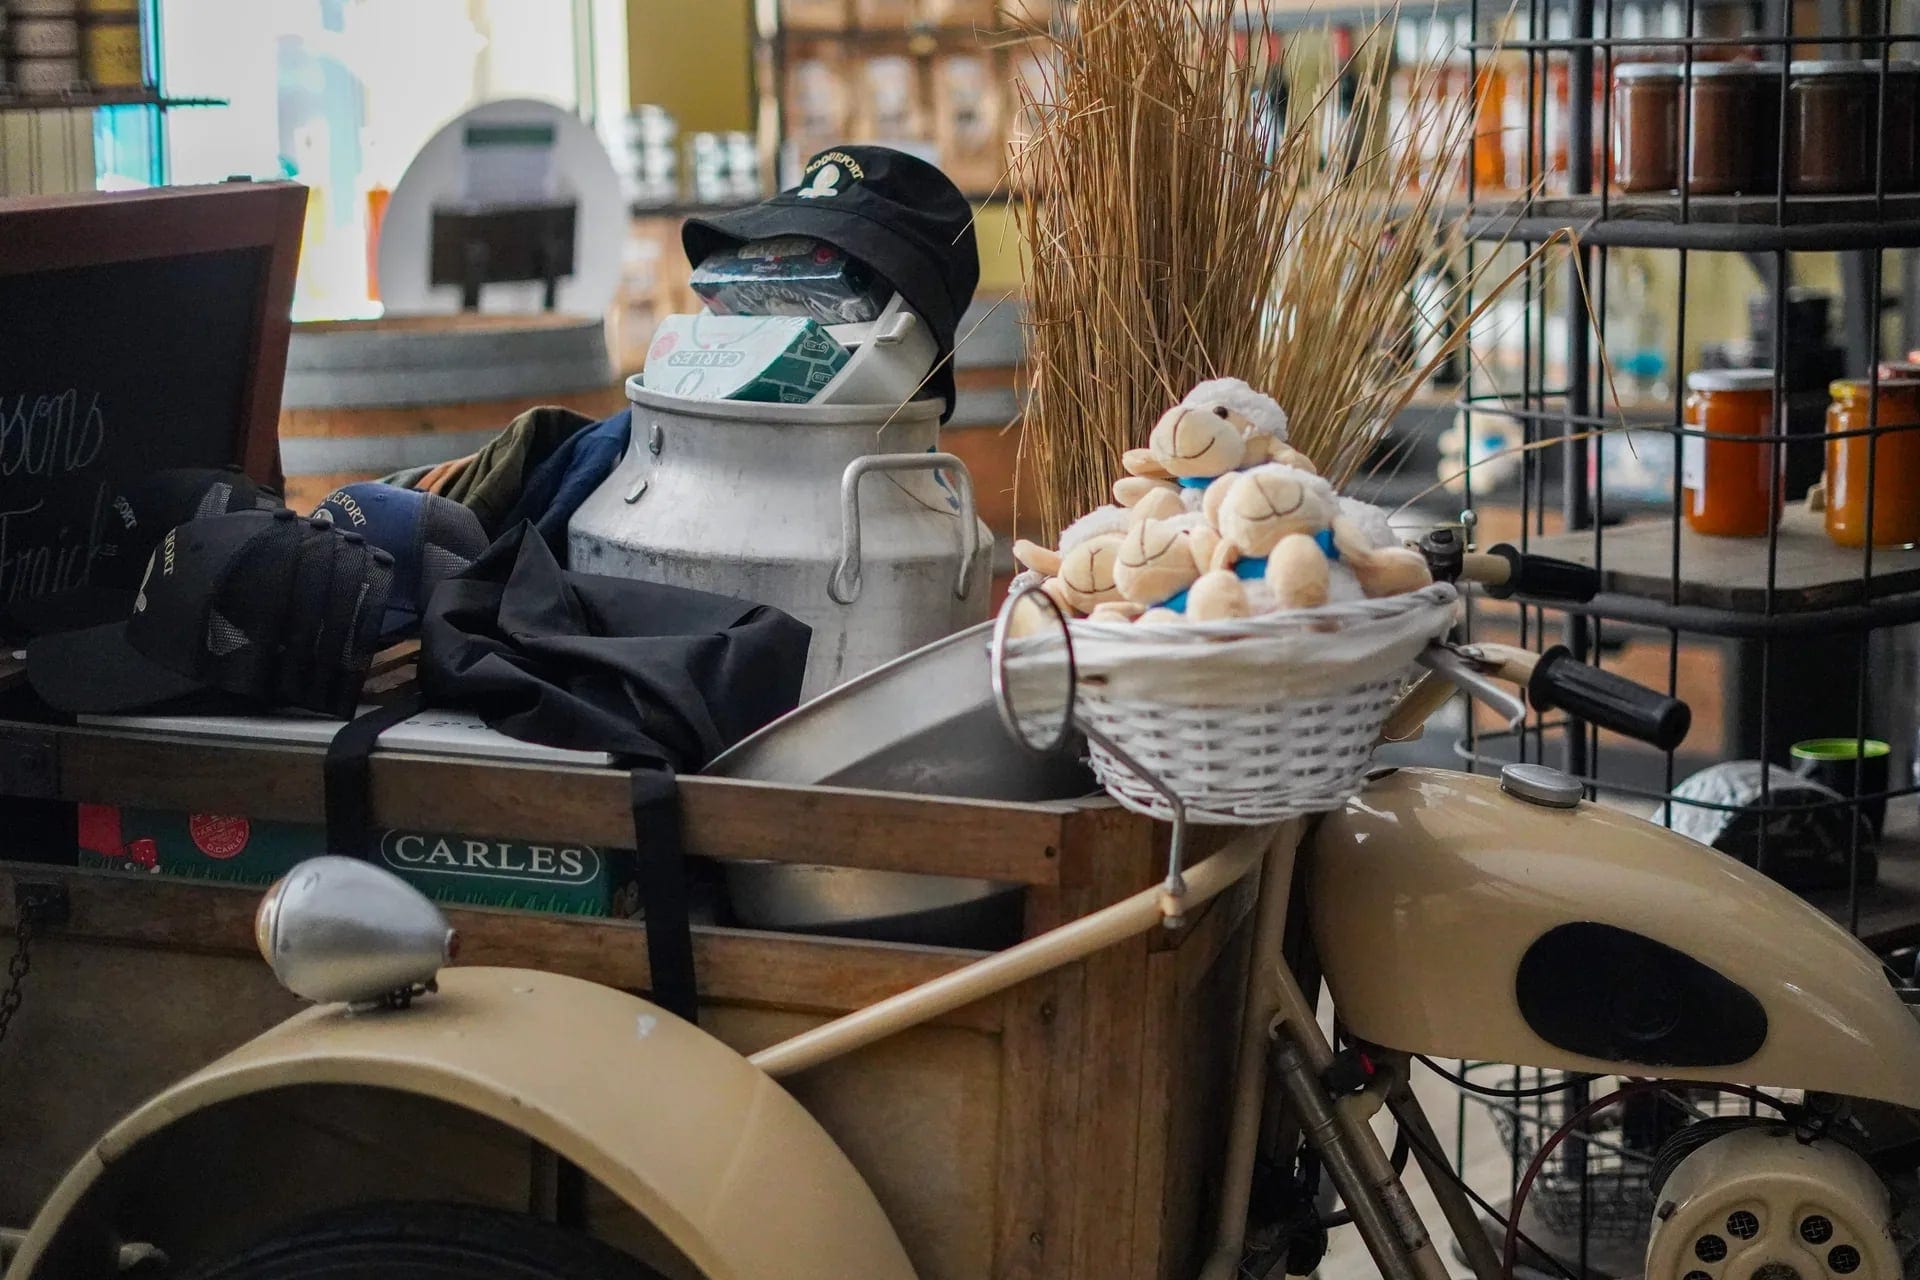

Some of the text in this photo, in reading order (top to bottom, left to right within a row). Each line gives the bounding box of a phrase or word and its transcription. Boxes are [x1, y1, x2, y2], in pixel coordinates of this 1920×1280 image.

[805, 151, 865, 180] ROQUEFORT
[671, 351, 741, 366] CARLES
[395, 834, 584, 877] CARLES
